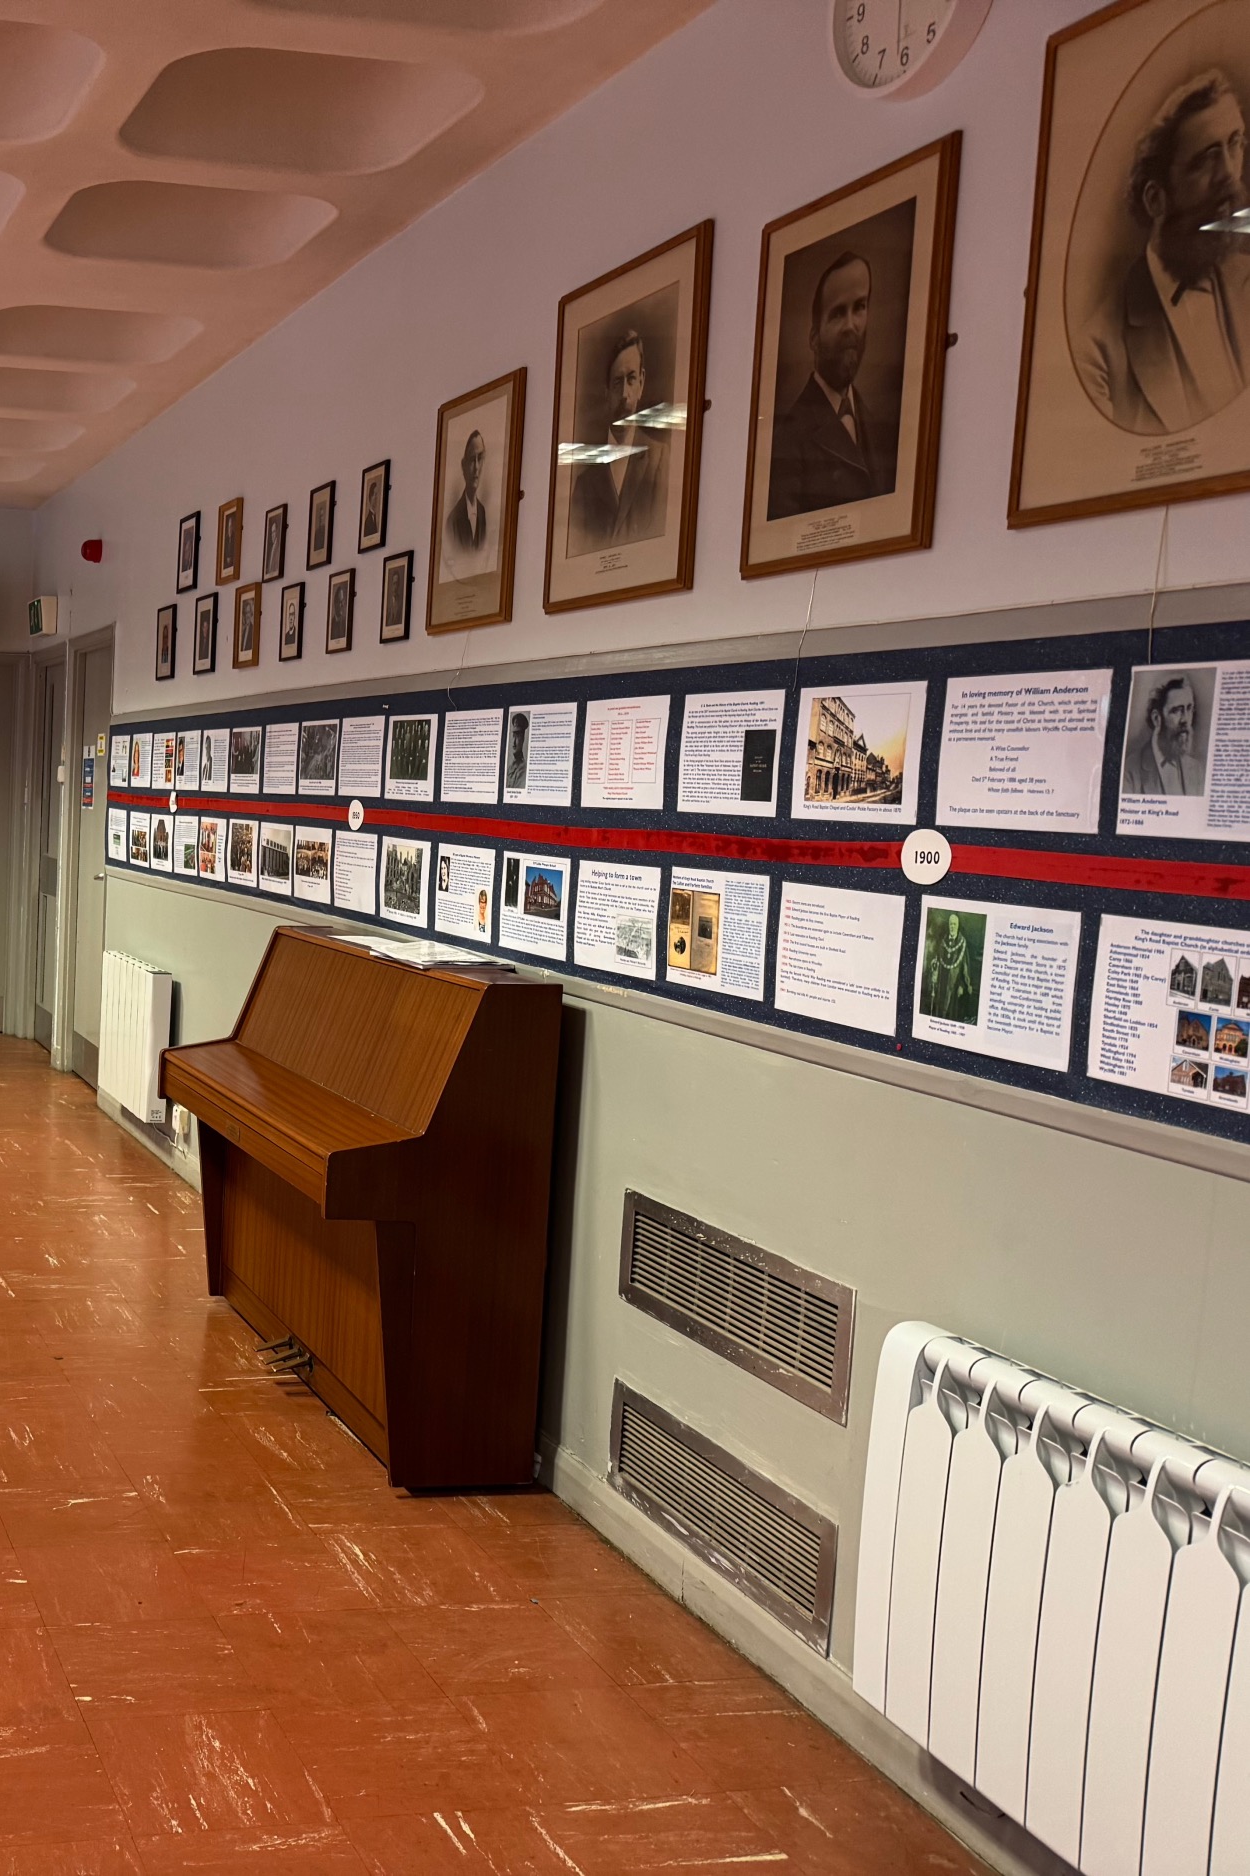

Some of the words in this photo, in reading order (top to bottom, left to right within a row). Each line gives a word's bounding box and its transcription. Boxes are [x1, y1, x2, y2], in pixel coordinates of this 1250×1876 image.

[857, 3, 865, 22] 9
[927, 21, 936, 44] 5
[861, 35, 869, 55] 8
[878, 48, 886, 70] 7
[900, 46, 909, 66] 6
[1052, 686, 1088, 694] Anderson
[1055, 810, 1080, 818] Sanctuary
[915, 851, 940, 864] 1900
[592, 870, 608, 880] Helping
[1010, 923, 1030, 931] Edward
[1184, 935, 1220, 944] granddaughter
[1208, 945, 1238, 954] alphabetical
